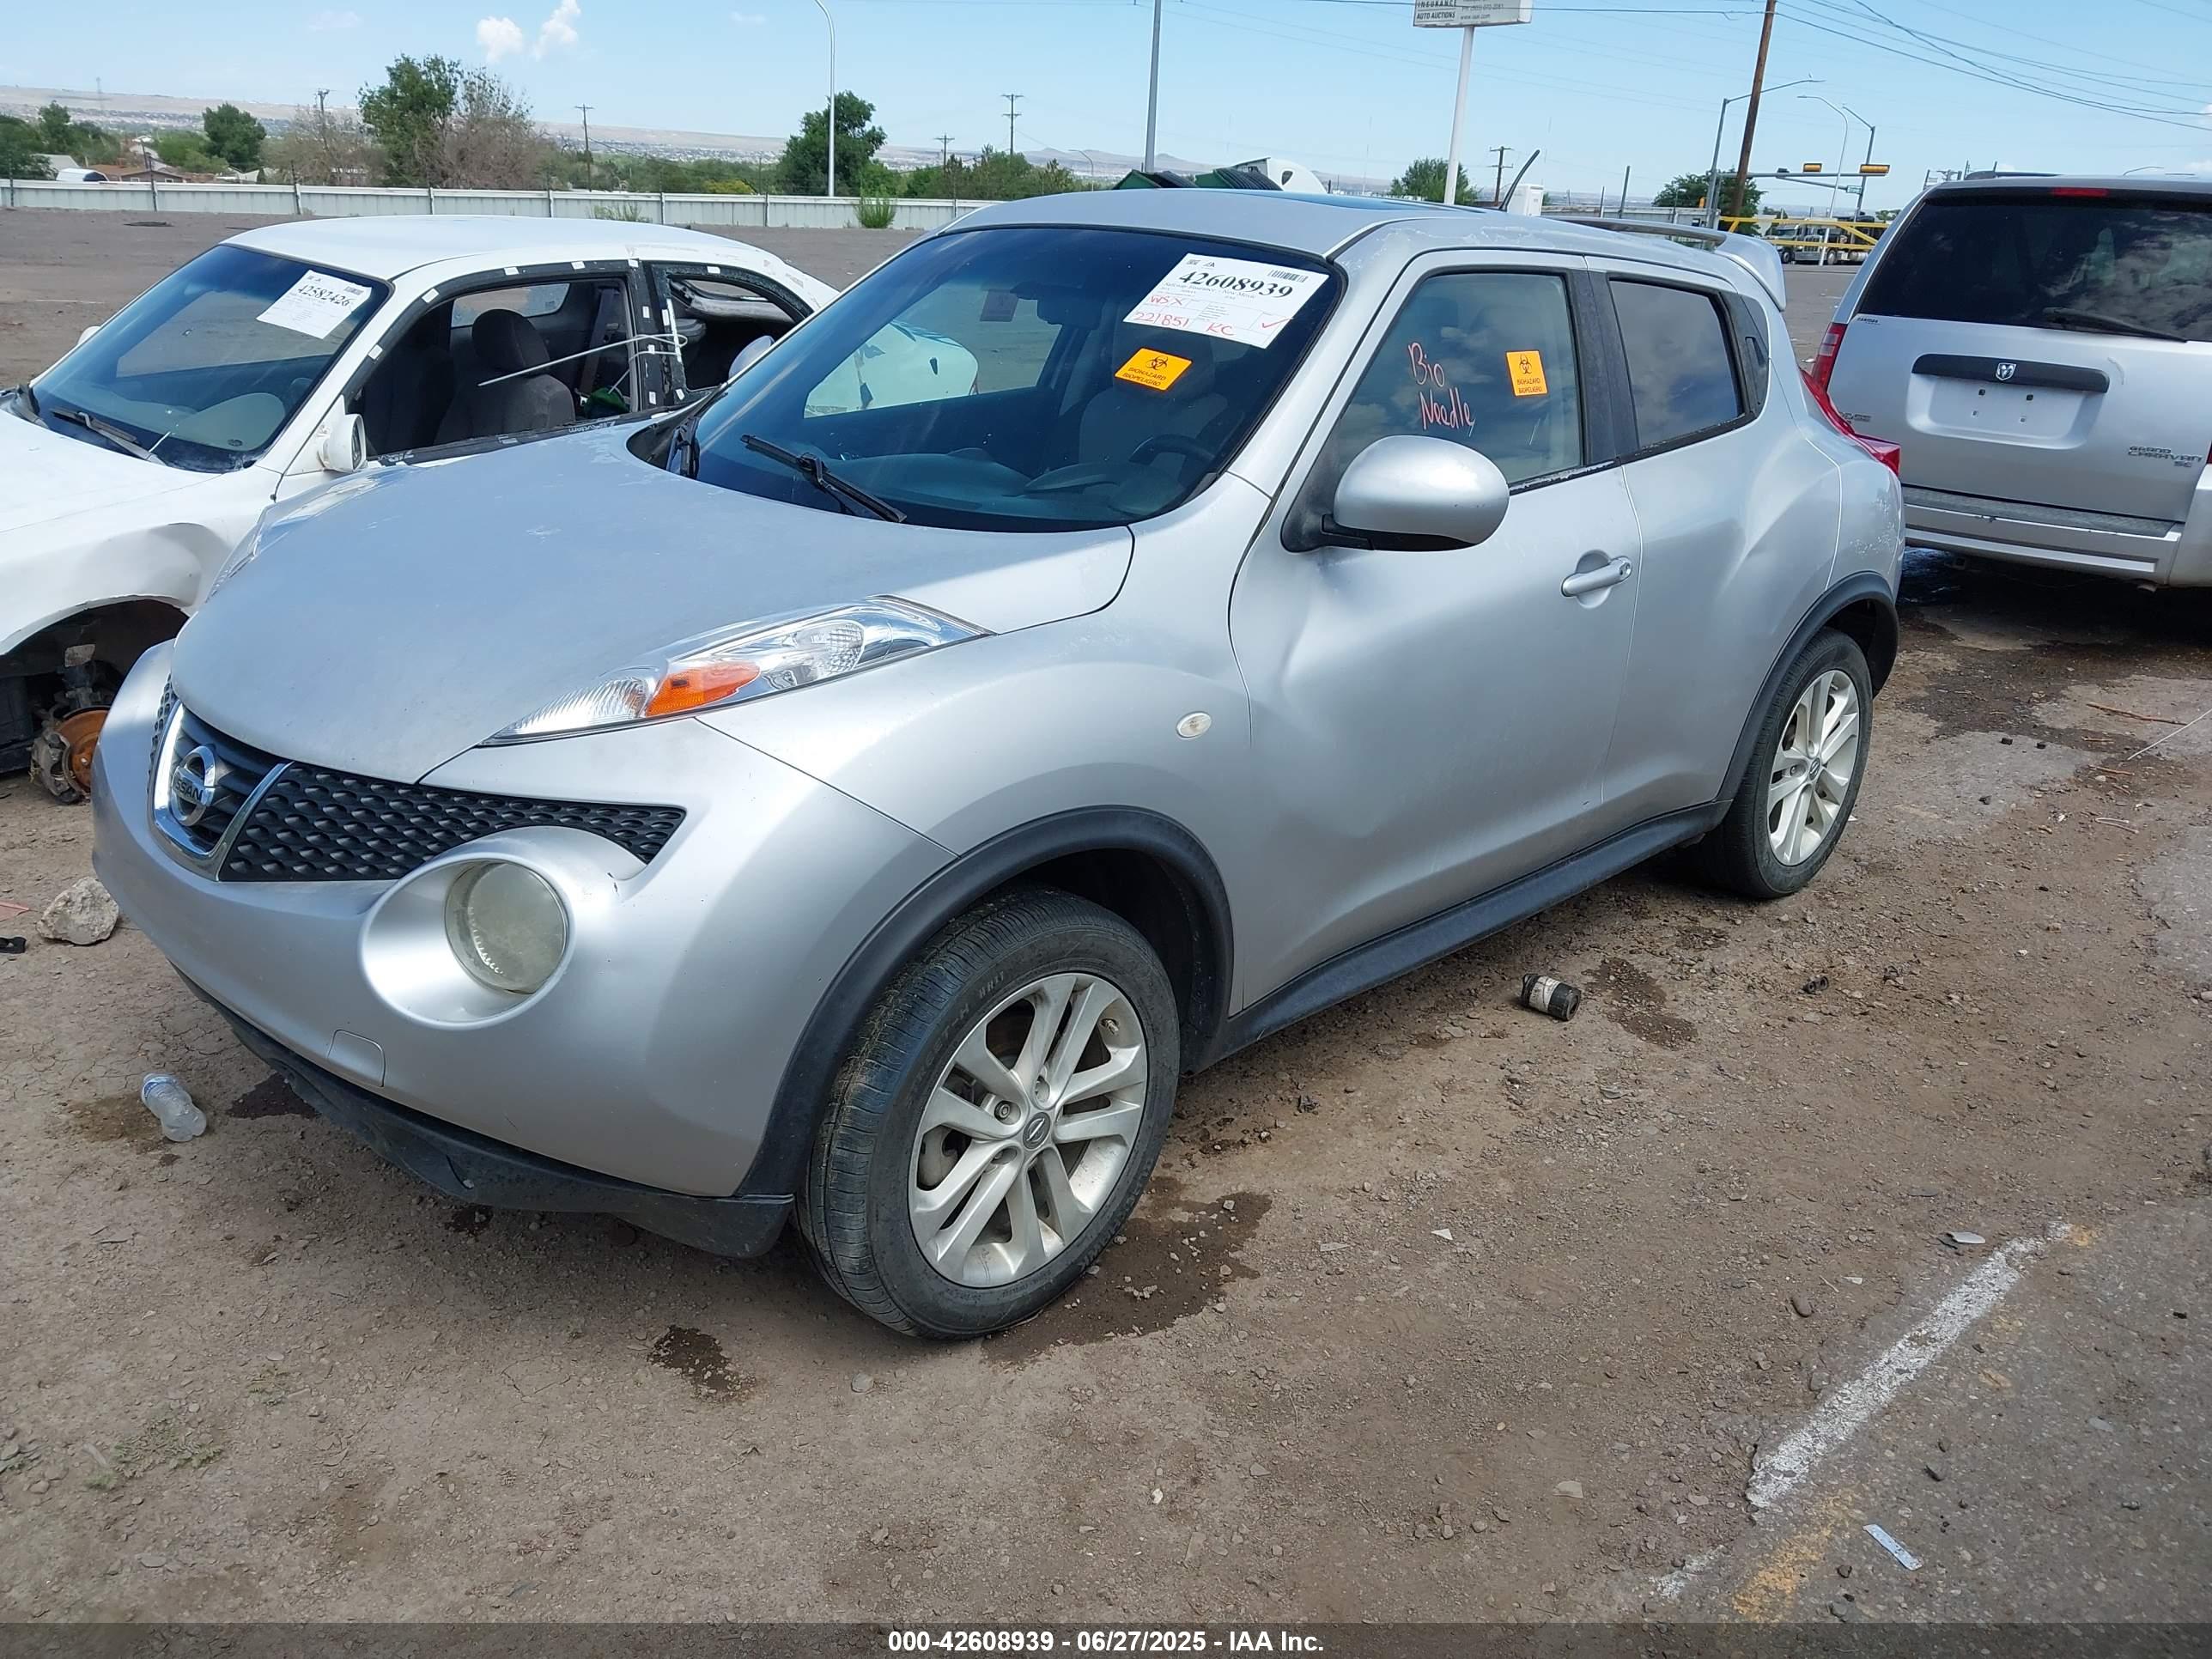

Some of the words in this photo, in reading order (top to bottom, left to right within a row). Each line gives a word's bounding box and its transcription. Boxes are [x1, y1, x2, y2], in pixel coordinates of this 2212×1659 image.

[1179, 270, 1294, 298] 42608939
[1206, 322, 1234, 336] KC
[1127, 367, 1167, 381] BIOHAZARD
[1408, 342, 1445, 387] Bio
[1419, 387, 1476, 430] Needle
[2128, 451, 2203, 462] CARAVAN
